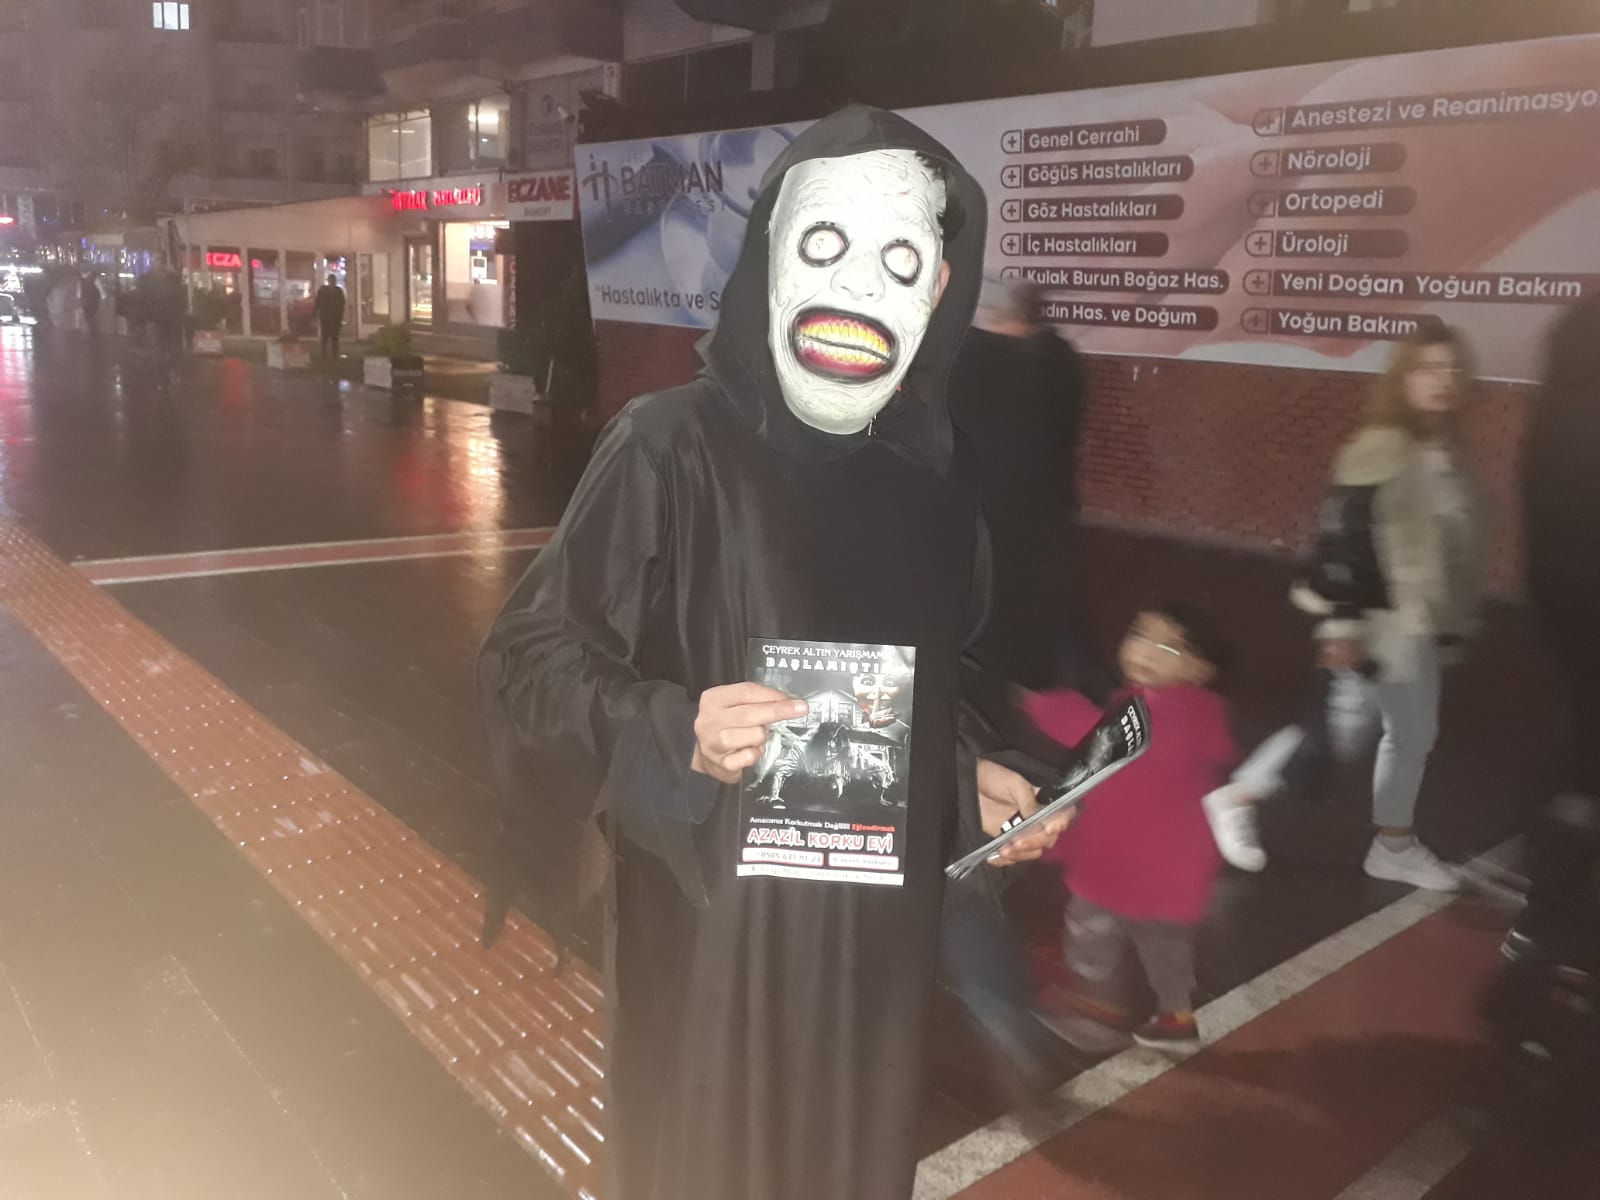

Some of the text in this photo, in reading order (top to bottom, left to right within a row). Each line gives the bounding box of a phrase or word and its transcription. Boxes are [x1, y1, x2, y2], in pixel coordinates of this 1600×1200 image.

[1292, 89, 1598, 128] Anestezi ve Reanimasyo
[1028, 125, 1140, 149] Genel Cerrahi
[1288, 147, 1371, 170] Nöroloji
[621, 160, 724, 196] BATMAN
[1028, 160, 1181, 184] Göğüs Hastalıkları
[1028, 201, 1157, 218] Göz Hastalıkları
[1285, 190, 1384, 214] Ortopedi
[1027, 234, 1137, 255] İç Hastalıkları
[1282, 232, 1349, 256] Üroloji
[1027, 269, 1224, 291] Kulak Burun Boğaz Has.
[1281, 273, 1582, 299] Yeni Doğan Yoğun Bakım
[685, 292, 705, 310] ve
[710, 291, 721, 311] S
[1040, 303, 1197, 327] dın Has. ve Doğum
[1279, 312, 1418, 335] Yoğun Bakım
[762, 644, 801, 656] ÇEYREK
[803, 647, 832, 658] ALTIN
[747, 826, 894, 854] AZAZİL KORKU EVİ
